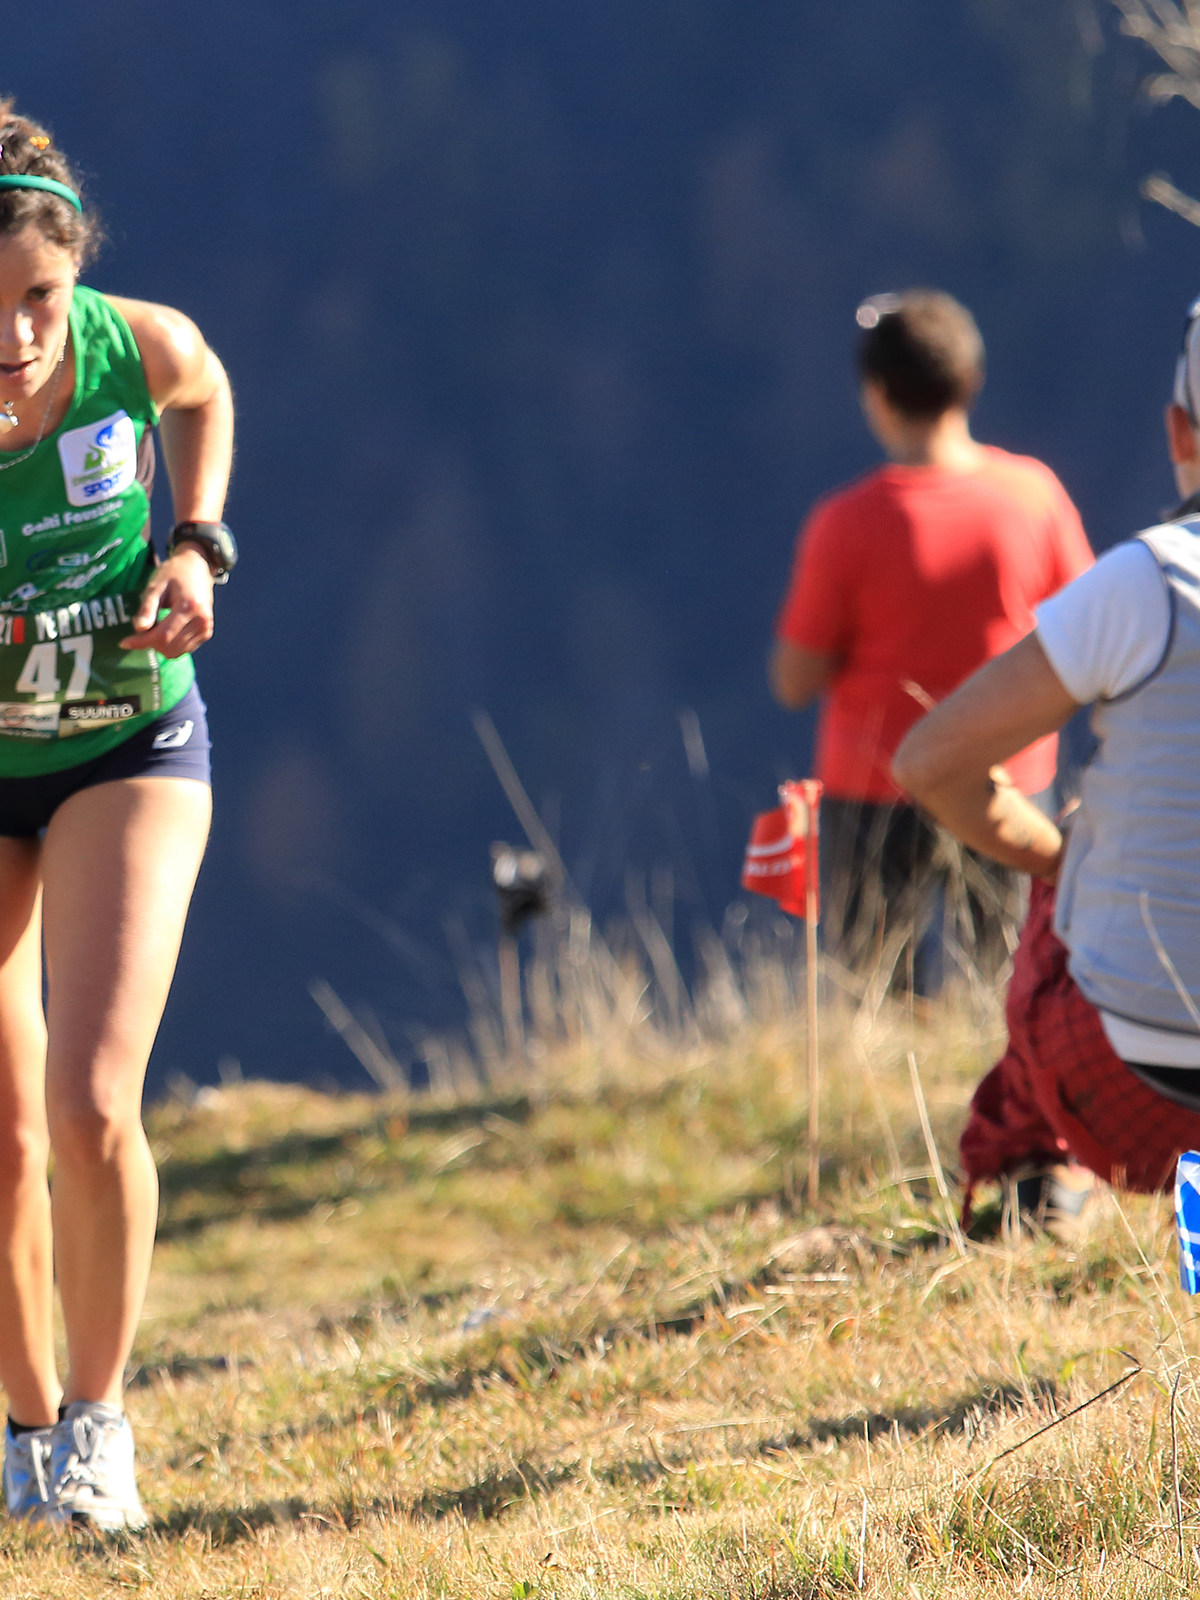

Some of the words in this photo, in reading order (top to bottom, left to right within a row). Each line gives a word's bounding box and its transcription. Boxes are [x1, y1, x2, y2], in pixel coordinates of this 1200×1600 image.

[35, 593, 132, 641] VERTICAL
[15, 634, 94, 703] 47
[68, 703, 134, 720] SUUNTO
